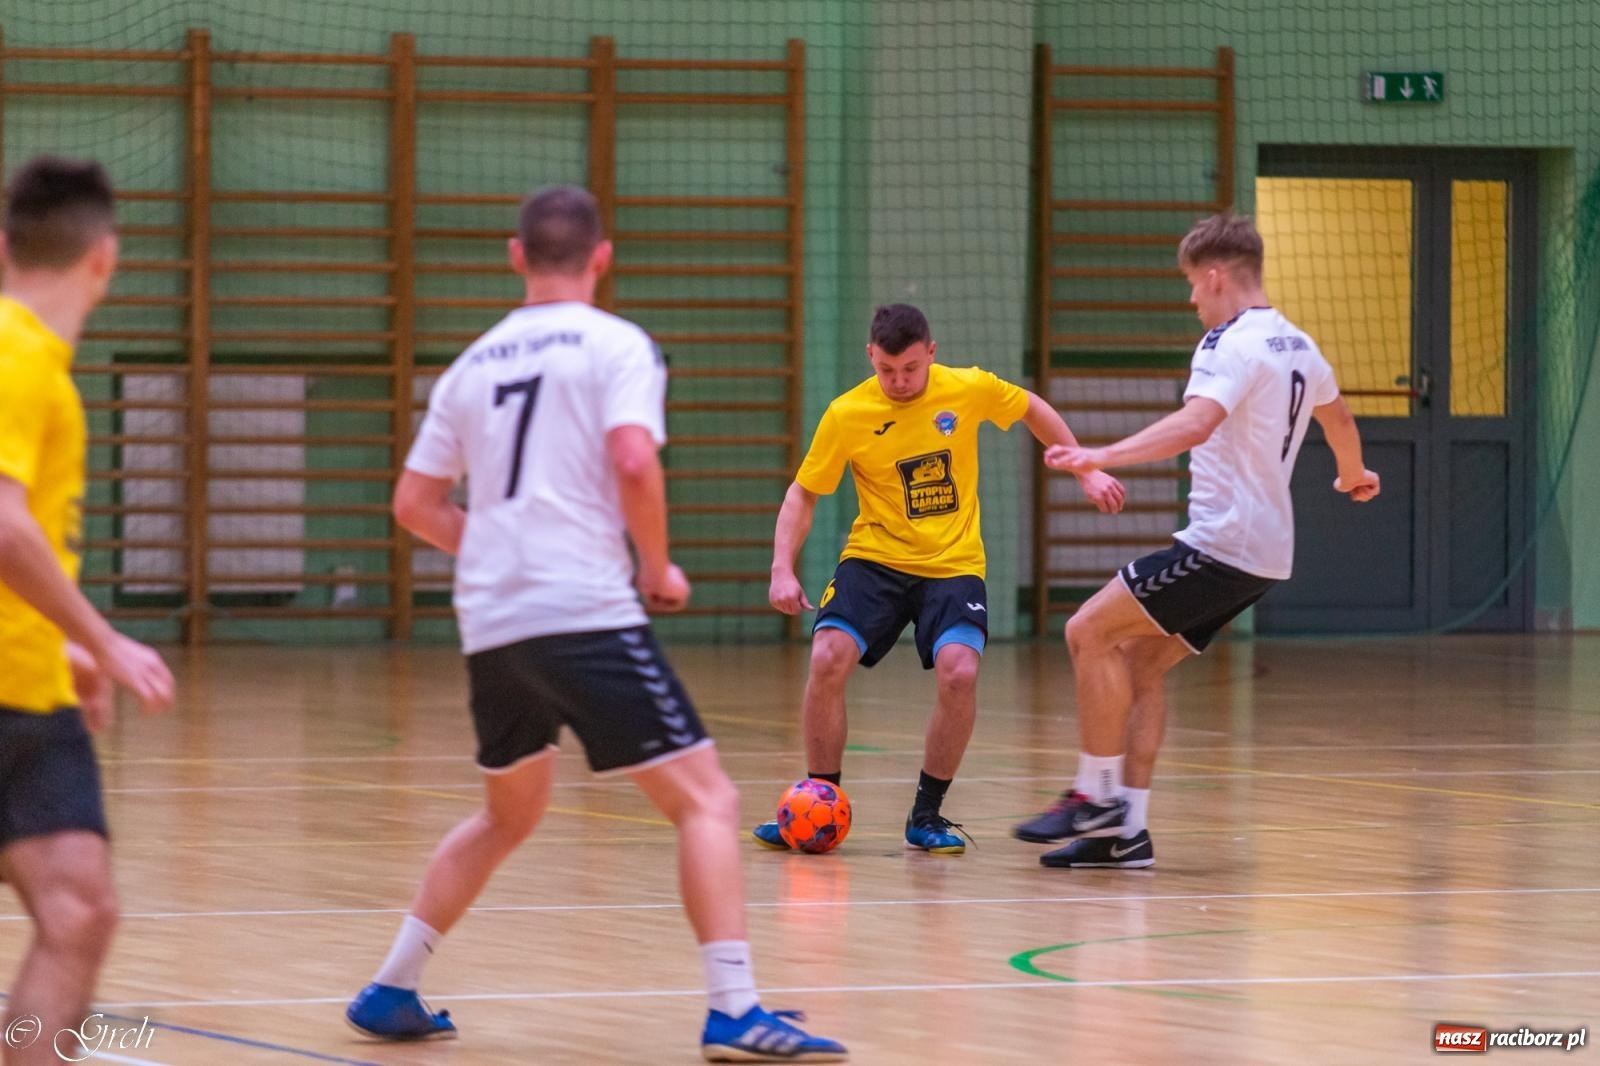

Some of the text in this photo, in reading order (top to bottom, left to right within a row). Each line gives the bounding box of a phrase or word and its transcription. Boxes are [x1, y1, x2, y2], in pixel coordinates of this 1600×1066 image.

[493, 373, 543, 500] 7
[1281, 369, 1305, 462] 9
[911, 494, 954, 509] GARAGE
